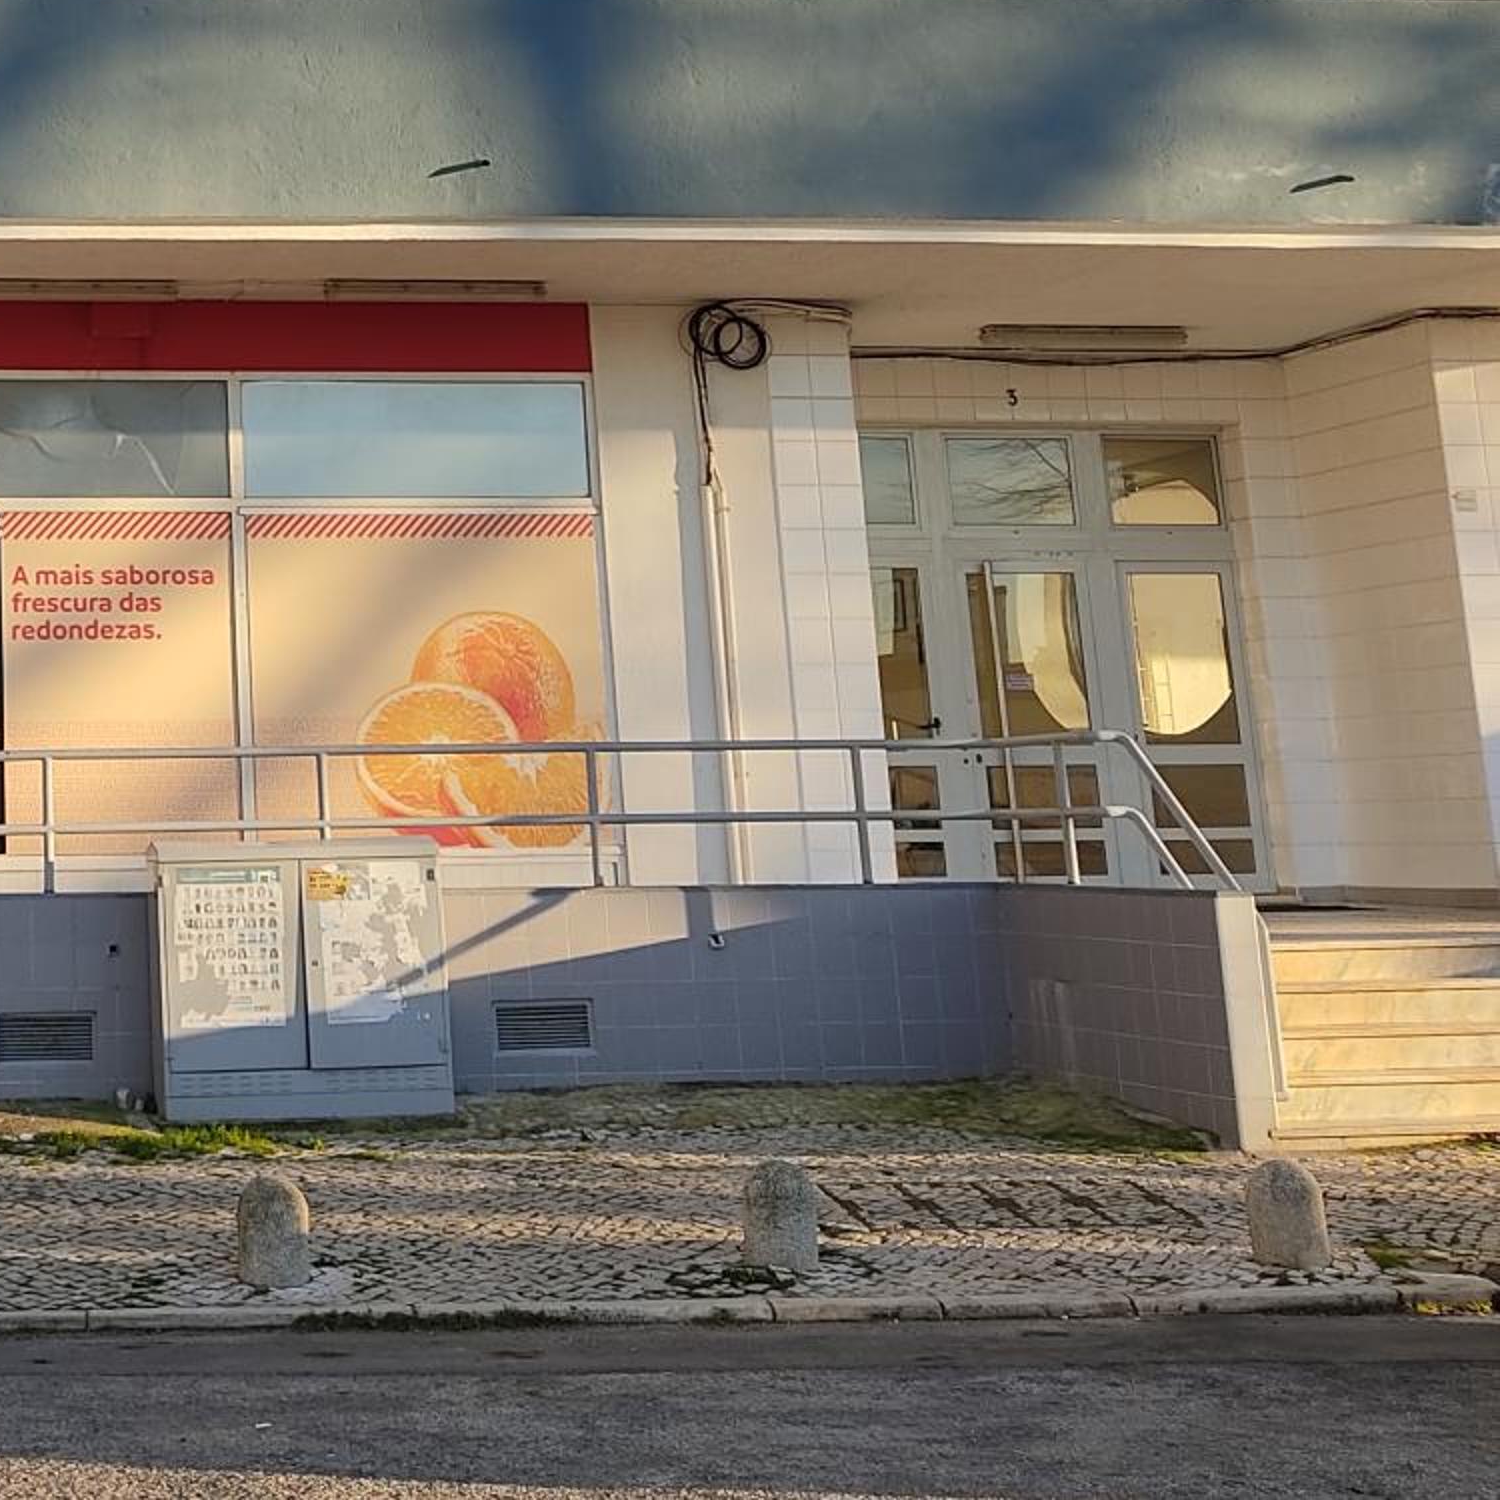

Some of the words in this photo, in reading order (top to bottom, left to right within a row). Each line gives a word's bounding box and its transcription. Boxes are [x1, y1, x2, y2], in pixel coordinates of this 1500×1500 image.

[1005, 388, 1018, 407] 3
[11, 565, 29, 585] A
[35, 564, 94, 585] mais
[101, 565, 215, 585] saborosa
[11, 592, 112, 613] frescura
[119, 592, 162, 613] das
[11, 620, 162, 640] redondezas.
